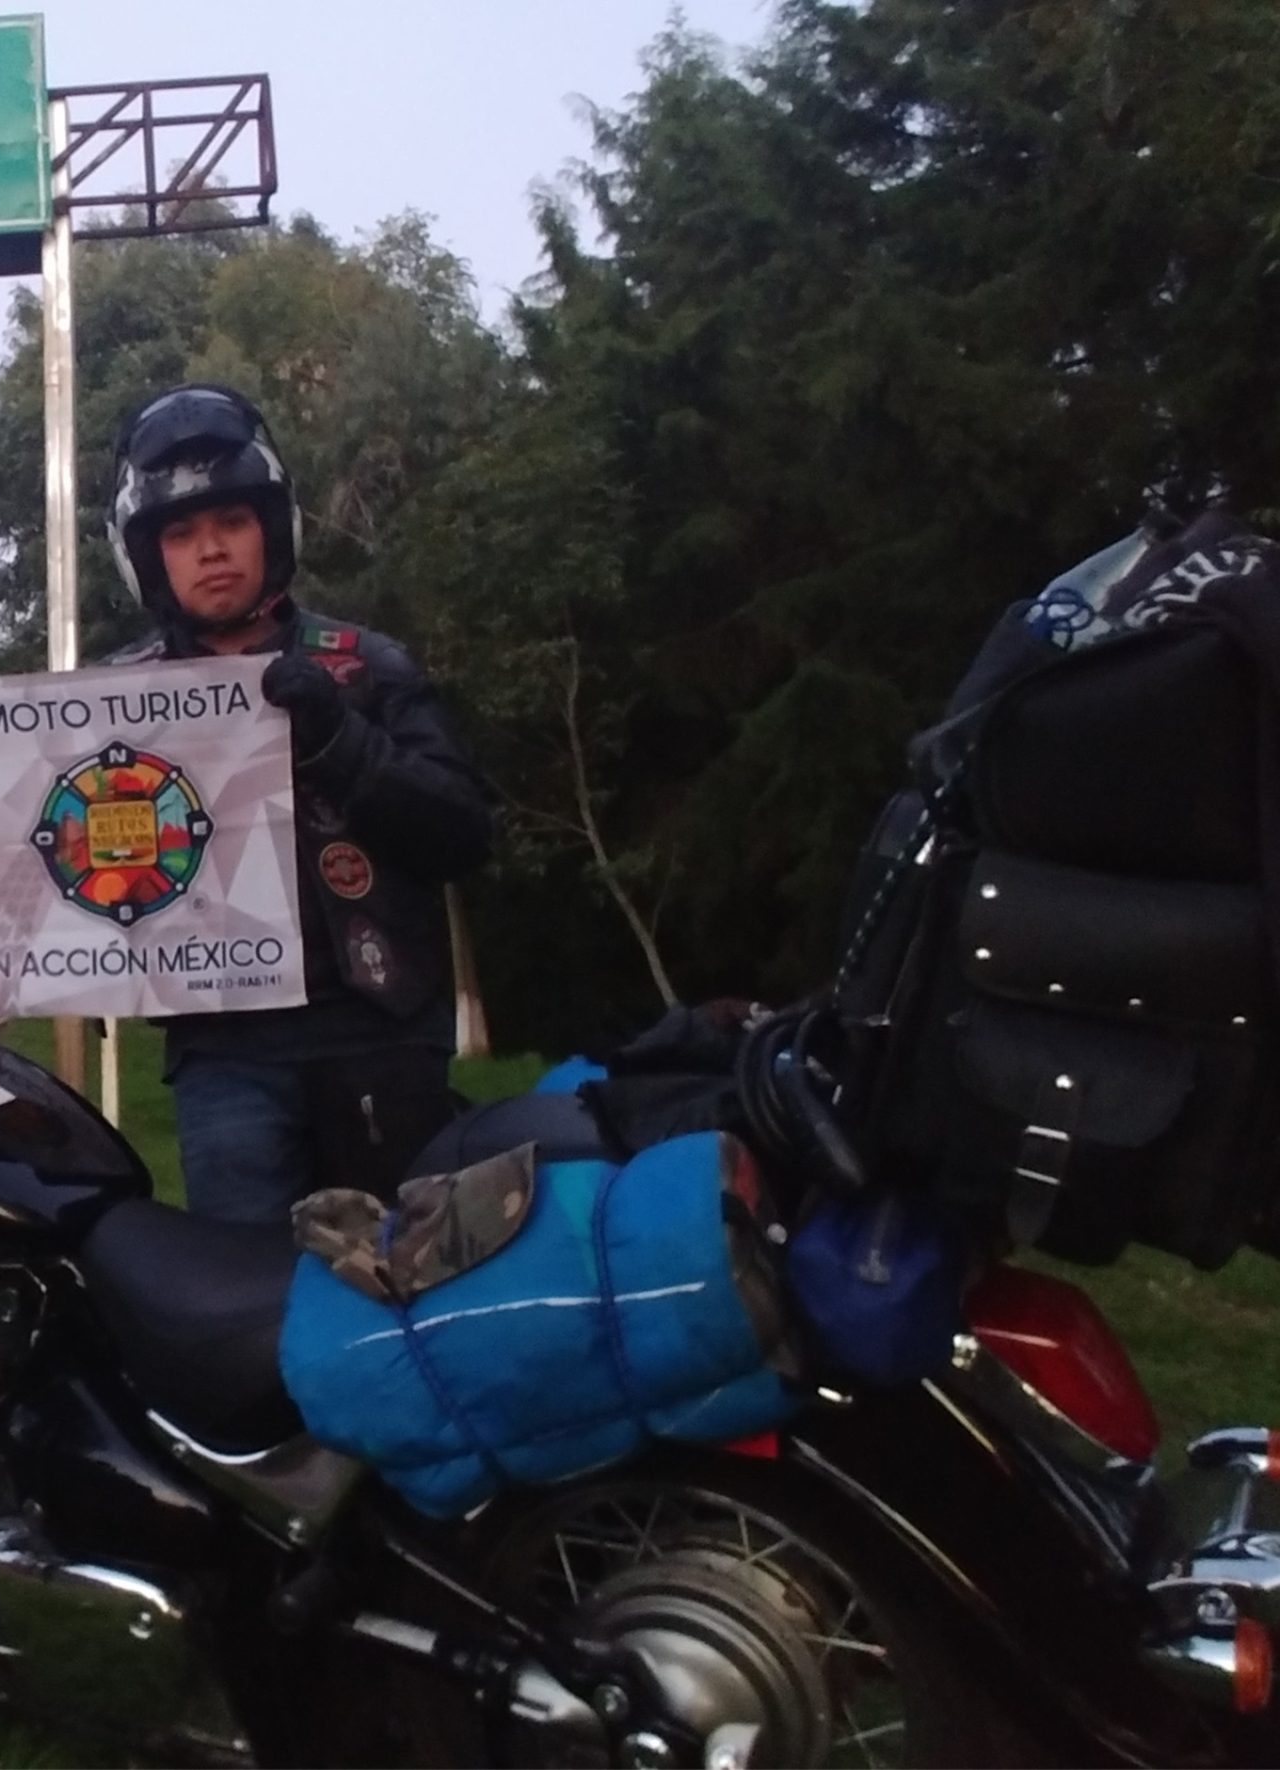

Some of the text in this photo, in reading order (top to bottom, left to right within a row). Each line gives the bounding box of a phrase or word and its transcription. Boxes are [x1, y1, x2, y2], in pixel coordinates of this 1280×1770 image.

[100, 681, 251, 726] TURISTA
[109, 749, 127, 763] N
[35, 831, 55, 846] O
[20, 939, 148, 978] ACCIÓN
[158, 935, 283, 973] MÉXICO
